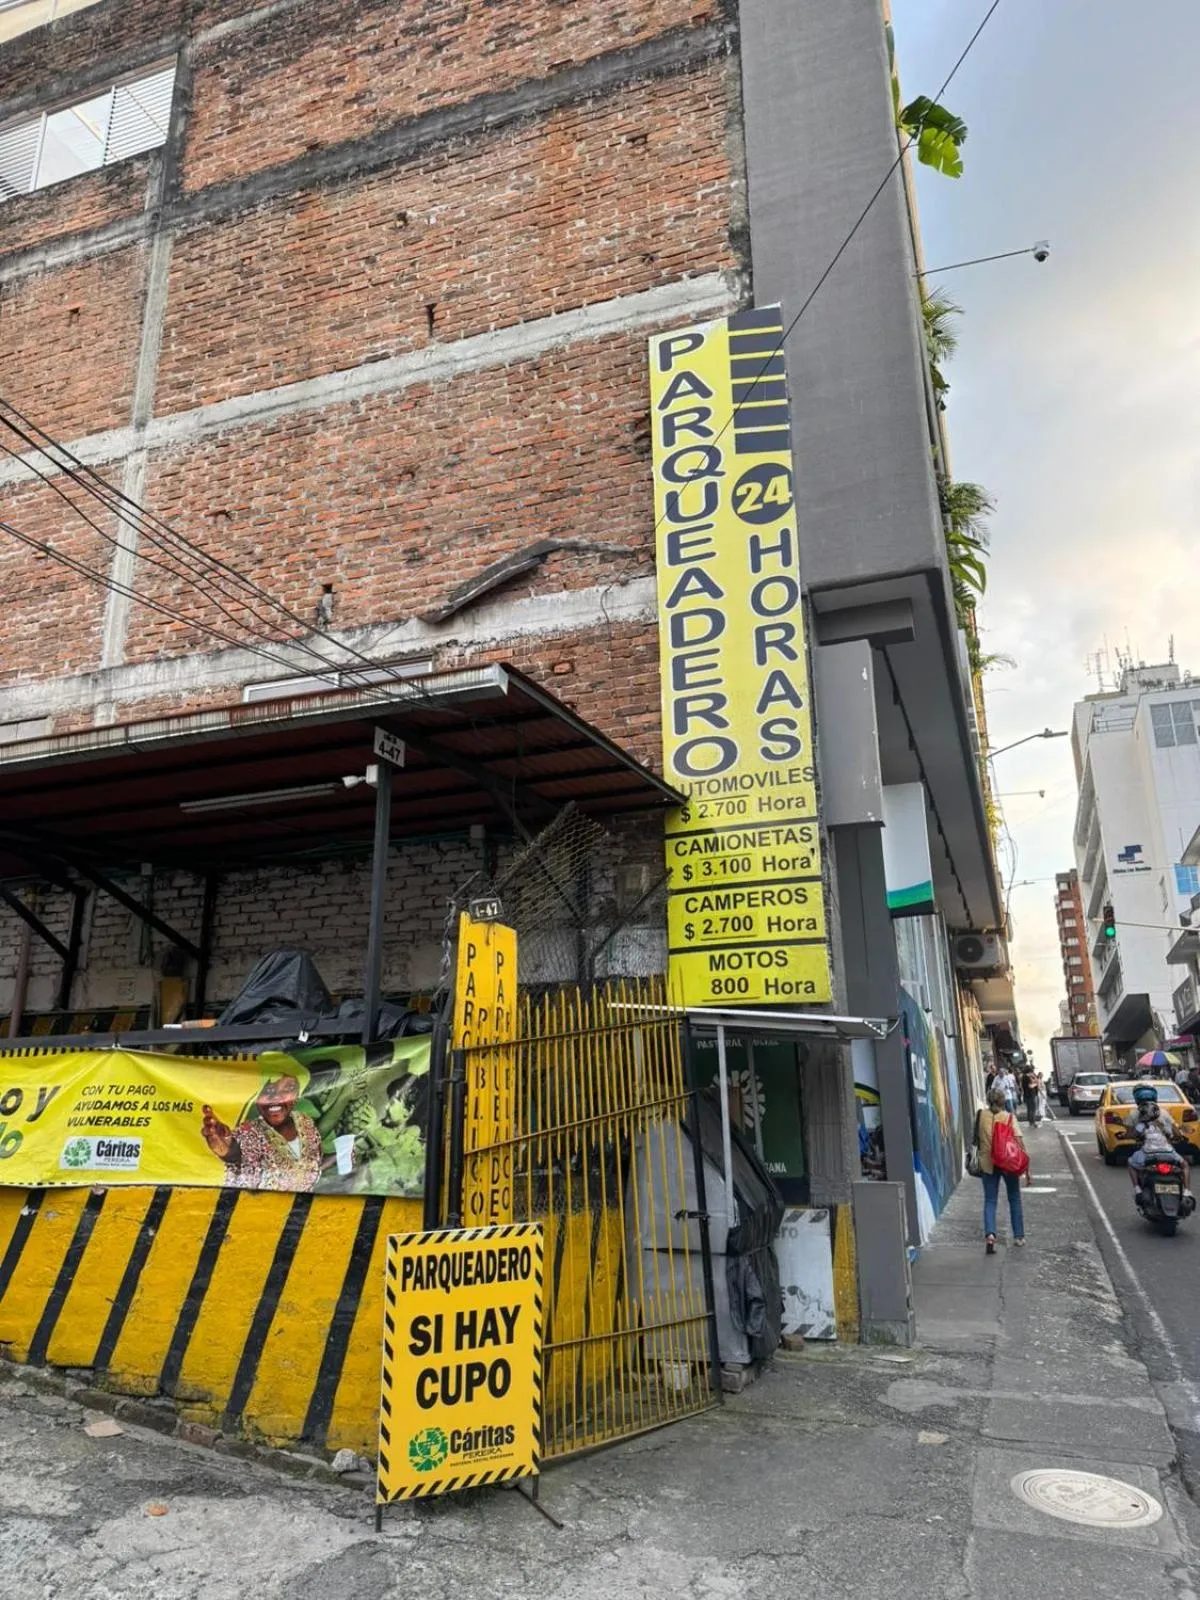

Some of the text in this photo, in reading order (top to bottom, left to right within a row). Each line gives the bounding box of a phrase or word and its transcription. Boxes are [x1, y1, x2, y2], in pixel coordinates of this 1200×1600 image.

[736, 474, 793, 513] 24
[657, 333, 738, 777] PARQUEADERO
[749, 528, 803, 762] HORAS
[674, 766, 815, 797] UTOMOVILES
[681, 796, 806, 823] $ 2.700 Hora
[674, 826, 813, 857] CAMIONETAS
[683, 856, 812, 881] $ 3.100 Hora
[685, 887, 809, 914] CAMPEROS
[684, 915, 817, 941] $ 2.700 Hora
[709, 950, 789, 972] MOTOS
[711, 977, 816, 995] 800 Hora
[82, 1085, 157, 1096] CON TU PAGO
[73, 1100, 194, 1113] AYUDAMOS A LOS MÁS
[67, 1116, 152, 1128] VULNERABLES
[96, 1139, 141, 1158] Cáritas
[401, 1245, 532, 1294] PARQUEADERO
[408, 1304, 522, 1357] SI HAY
[415, 1357, 512, 1410] CUPO
[450, 1424, 515, 1454] Cáritas
